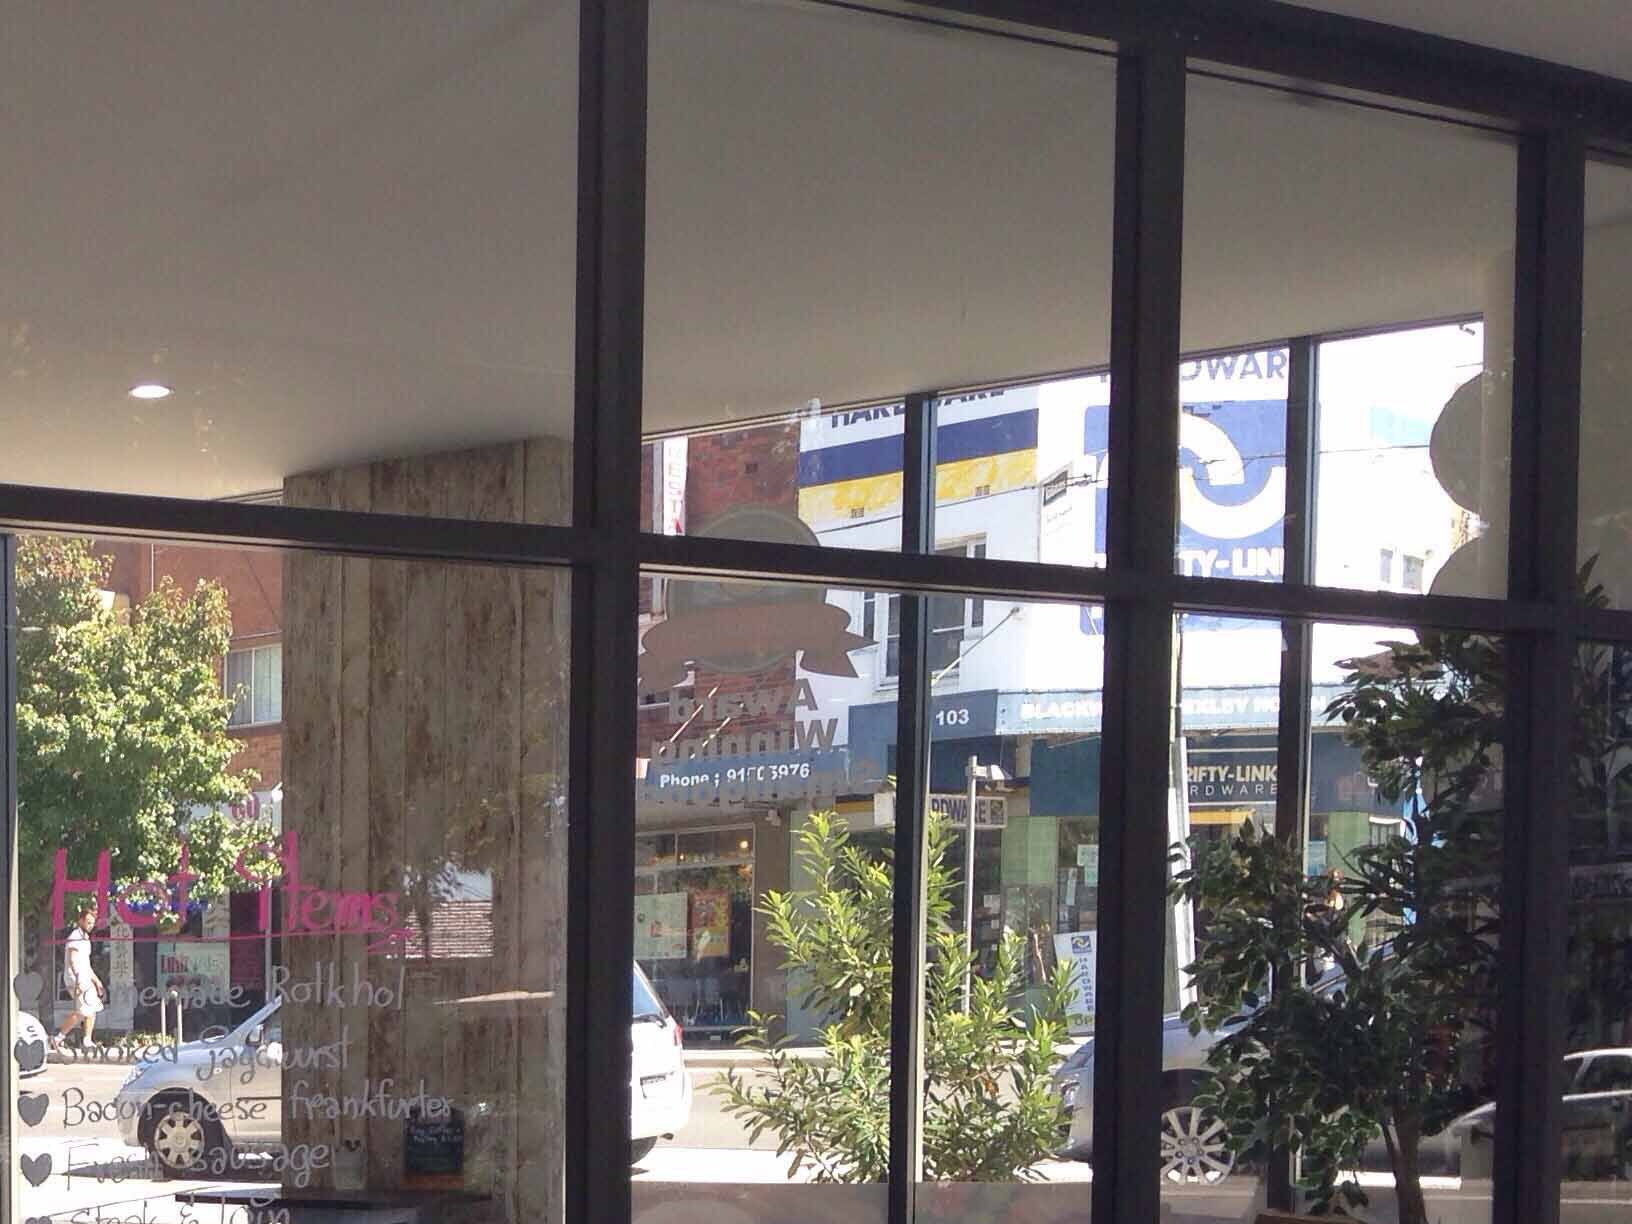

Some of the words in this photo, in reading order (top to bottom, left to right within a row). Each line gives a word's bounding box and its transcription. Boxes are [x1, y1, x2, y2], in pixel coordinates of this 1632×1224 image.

[934, 709, 970, 727] 103
[51, 837, 200, 930] Hot
[234, 831, 401, 931] Items
